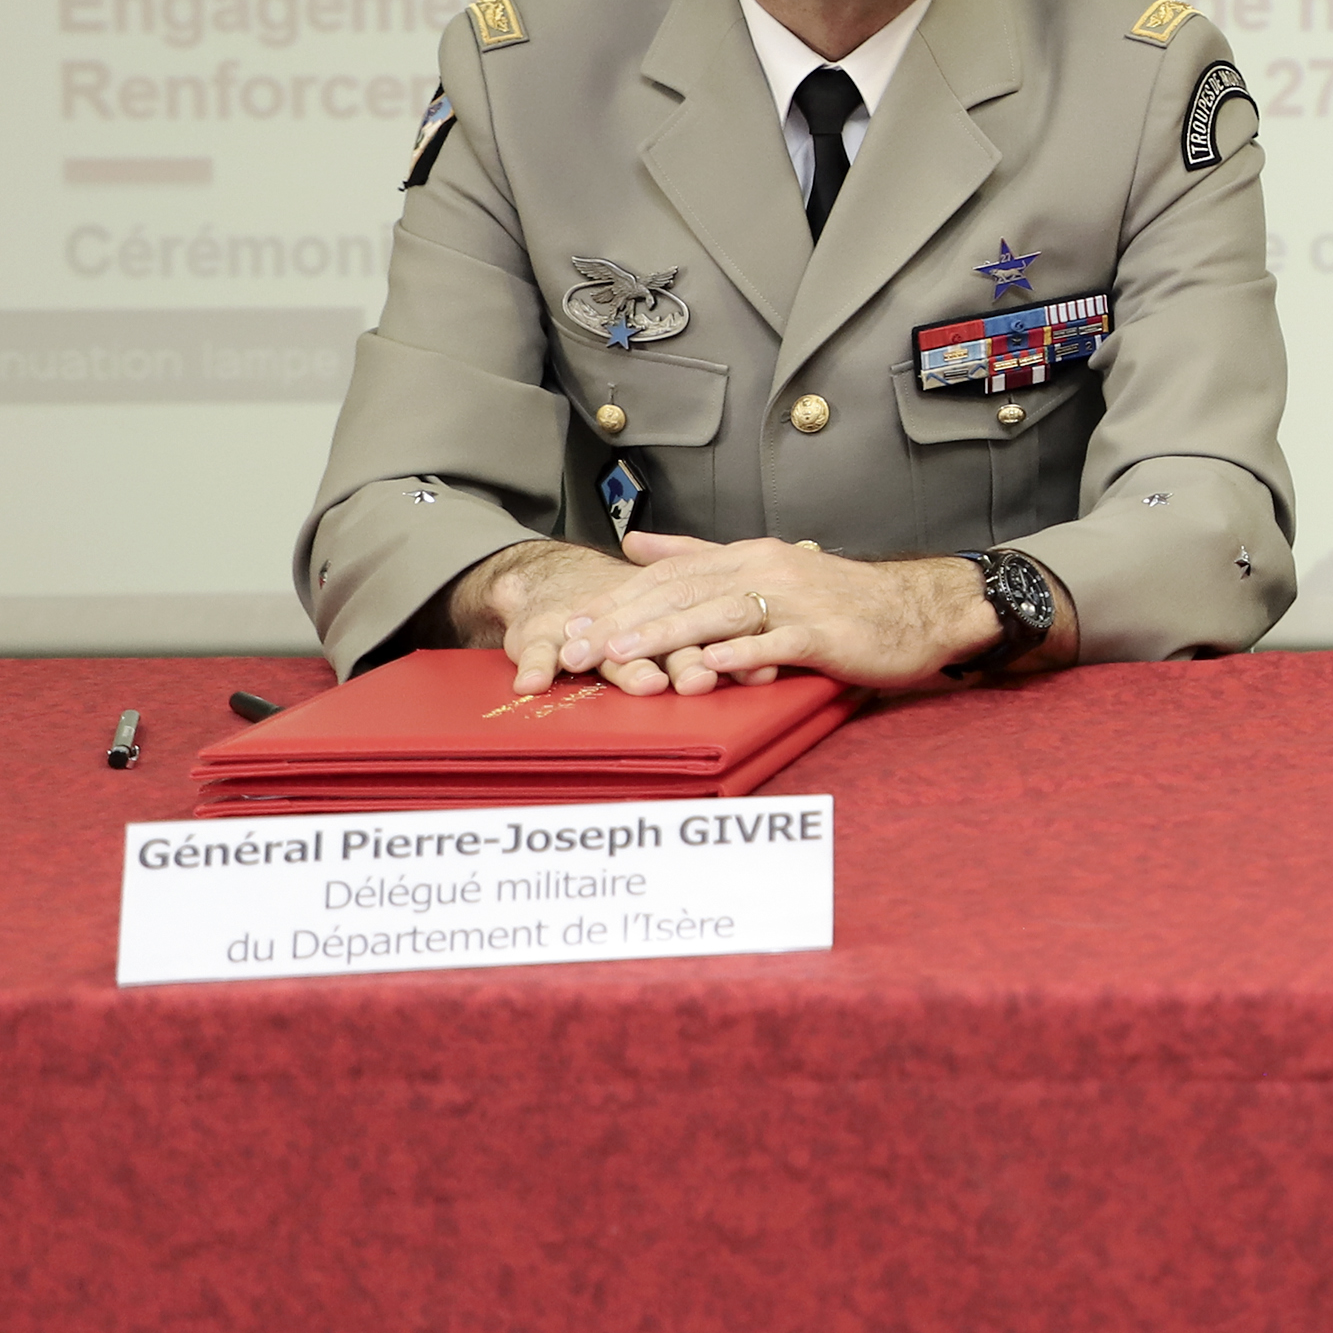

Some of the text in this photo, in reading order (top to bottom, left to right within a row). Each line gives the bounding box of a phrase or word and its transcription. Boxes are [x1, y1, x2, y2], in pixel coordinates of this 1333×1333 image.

[1190, 84, 1216, 155] TROUPES
[1208, 72, 1225, 95] DE
[63, 221, 393, 281] Cérémoni
[1000, 252, 1012, 264] 27
[200, 340, 343, 388] lampe
[137, 810, 823, 870] Général Pierre-Joseph GIVRE
[323, 869, 648, 914] Délégué militaire
[226, 931, 275, 965] du
[291, 920, 548, 965] Département
[561, 915, 608, 946] de
